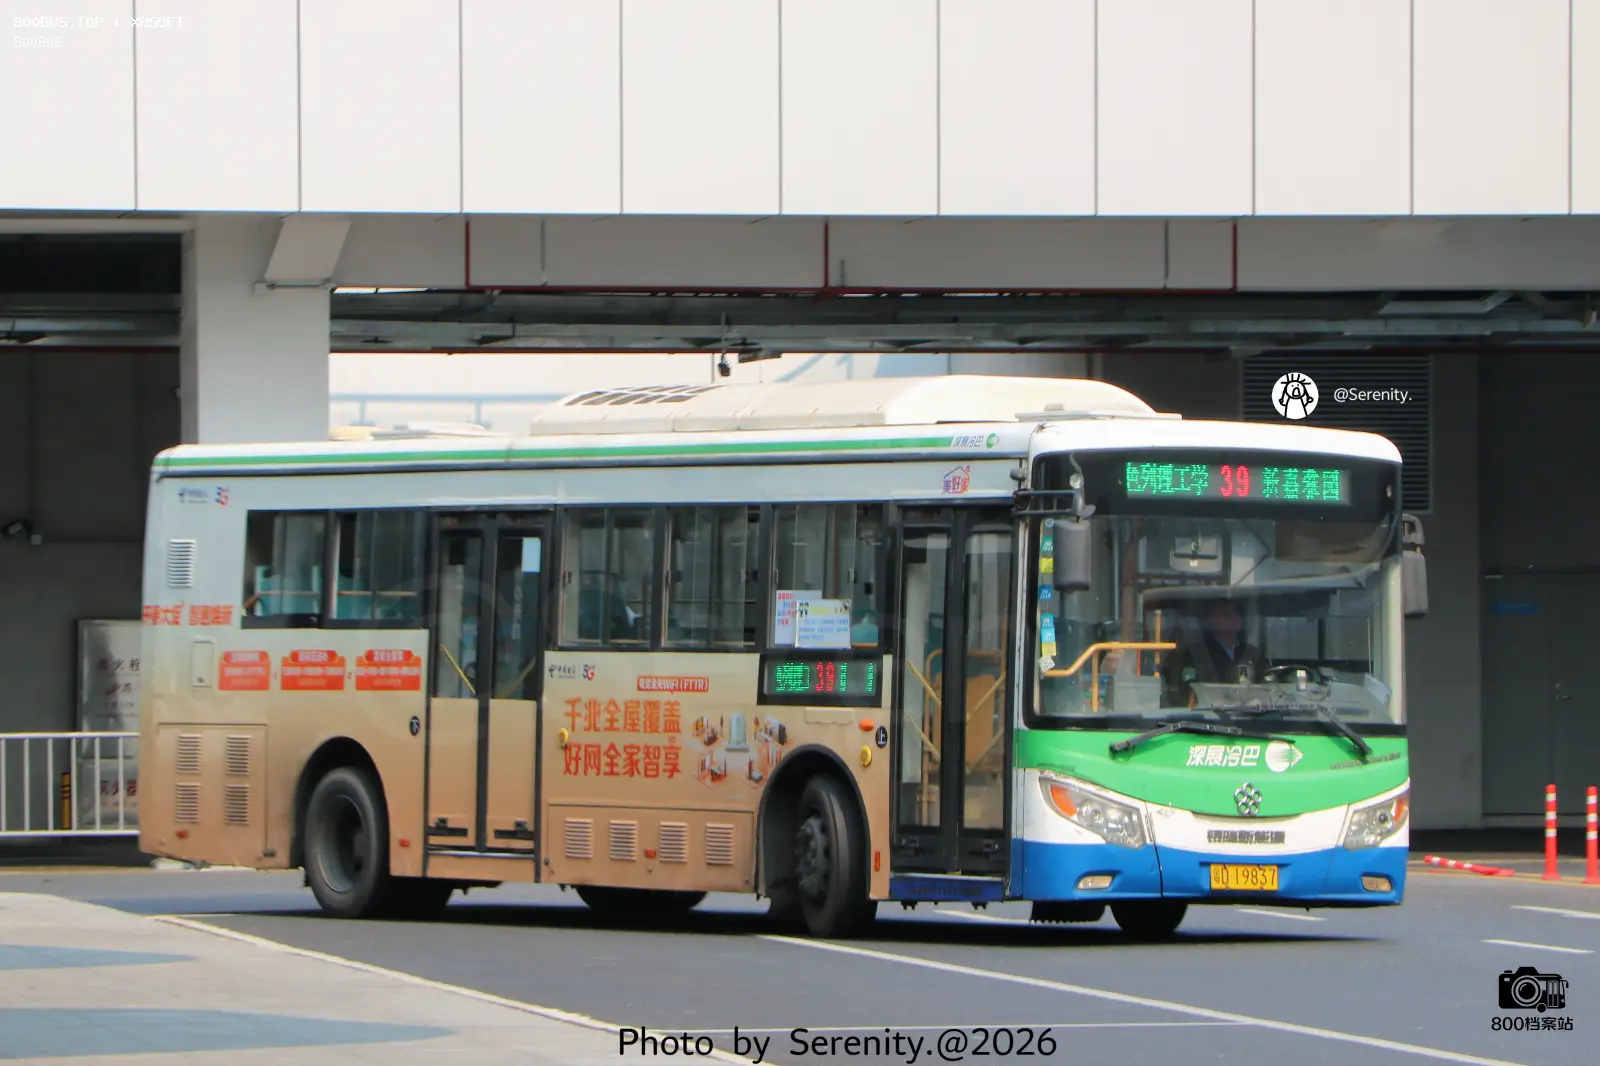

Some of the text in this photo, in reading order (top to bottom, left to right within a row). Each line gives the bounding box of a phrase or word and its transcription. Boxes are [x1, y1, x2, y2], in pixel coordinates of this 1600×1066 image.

[1219, 464, 1250, 498] 39
[815, 661, 836, 692] 39
[409, 718, 420, 733] 下
[564, 696, 682, 734] 千兆全屋覆盖
[877, 729, 887, 745] 上
[563, 742, 682, 779] 好网全家智享
[1186, 744, 1261, 767] 深展冷巴
